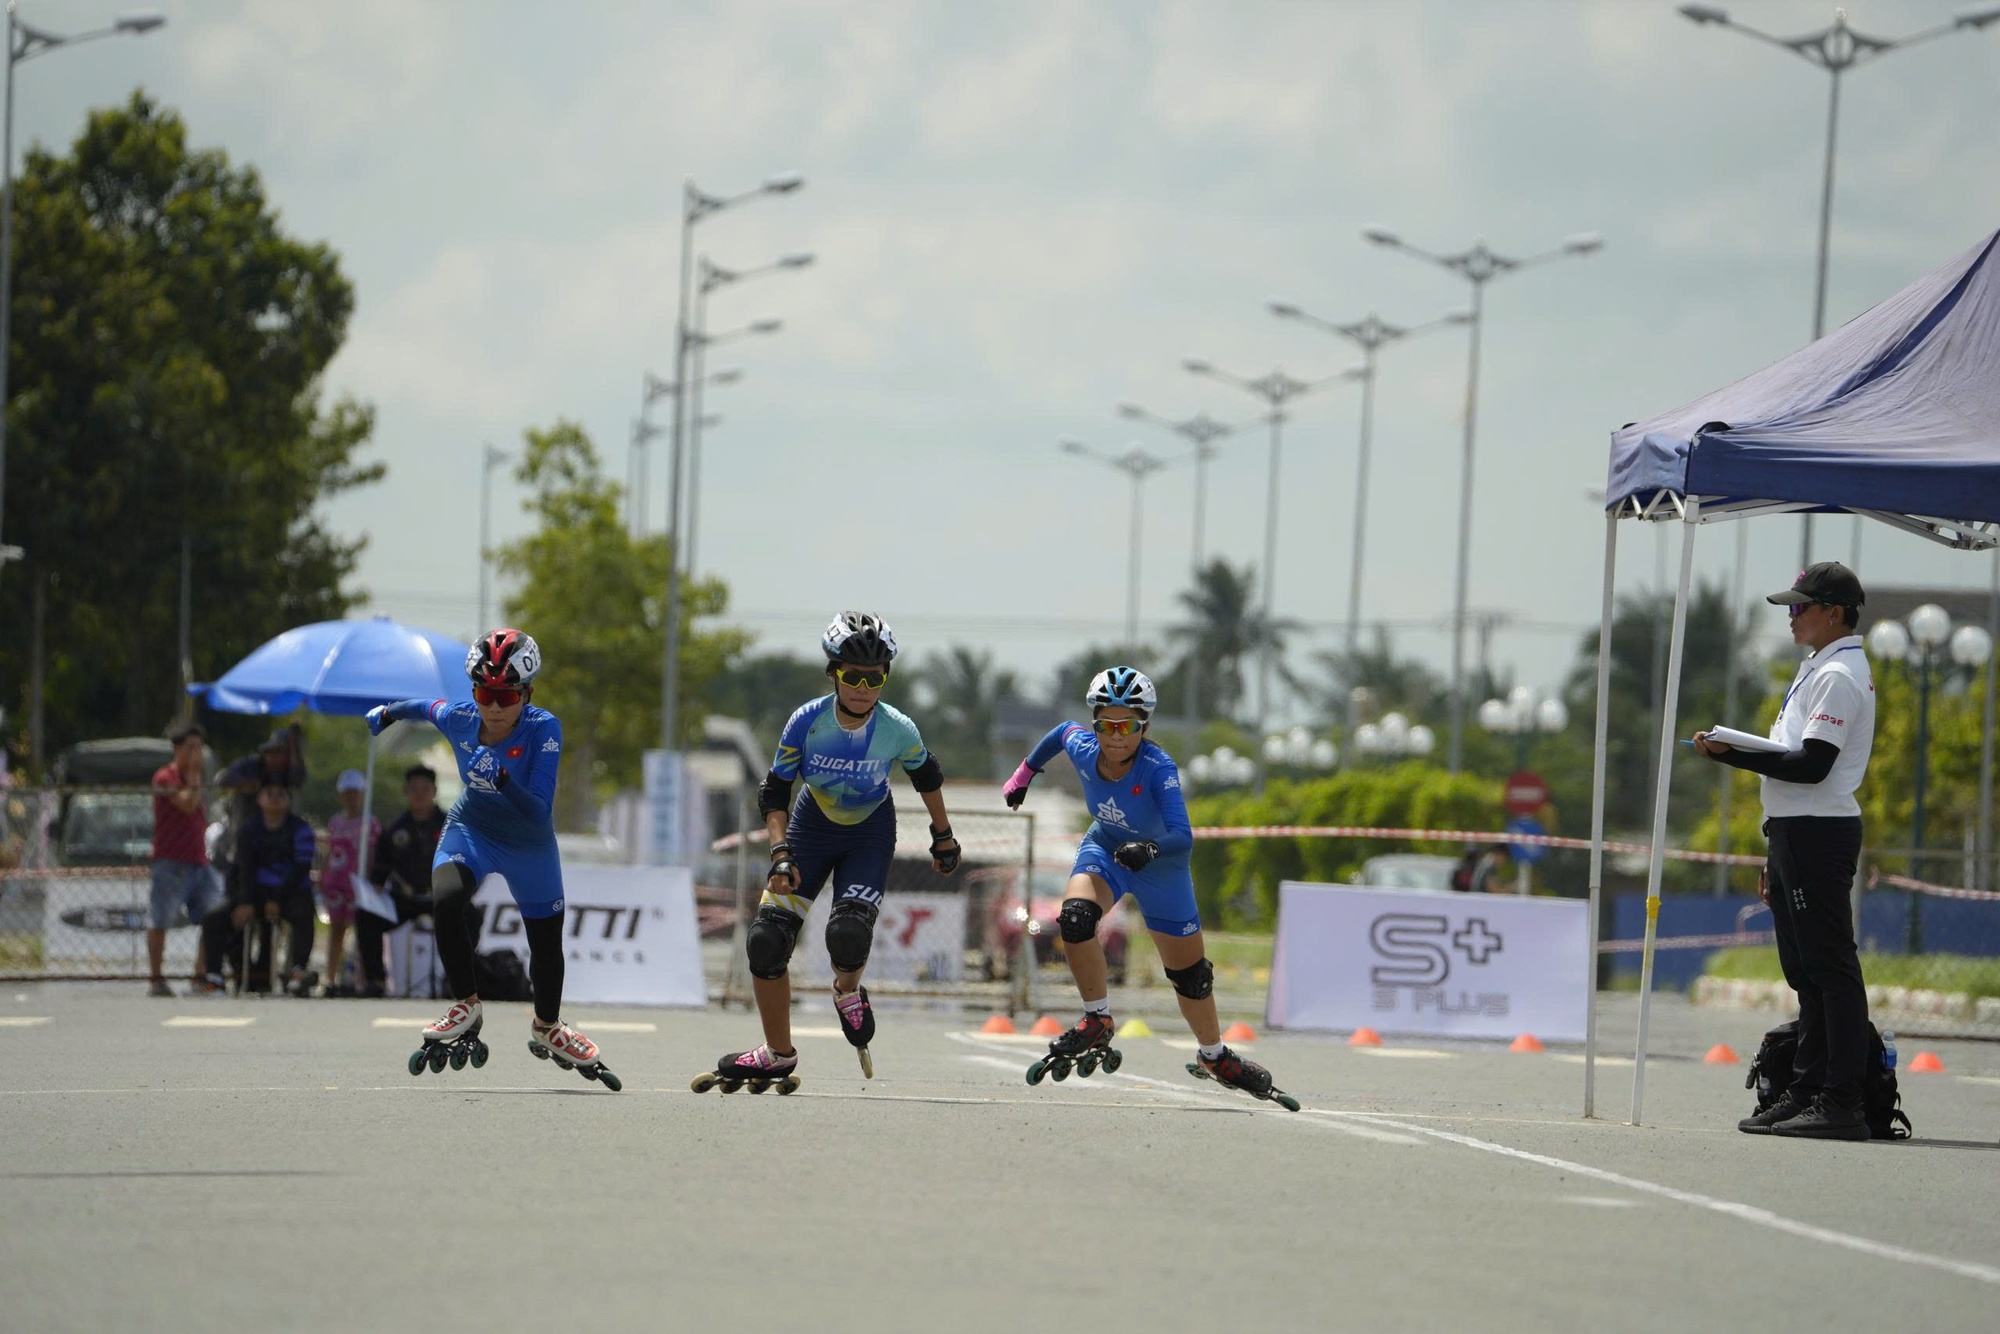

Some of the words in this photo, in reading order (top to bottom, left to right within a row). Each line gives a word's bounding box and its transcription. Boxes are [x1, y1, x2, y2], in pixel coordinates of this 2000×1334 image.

[782, 699, 822, 740] SUGATTI
[1809, 713, 1844, 727] JUDGE
[809, 753, 880, 772] SUGATTI
[1372, 988, 1400, 1011] S
[1412, 989, 1510, 1016] PLUS
